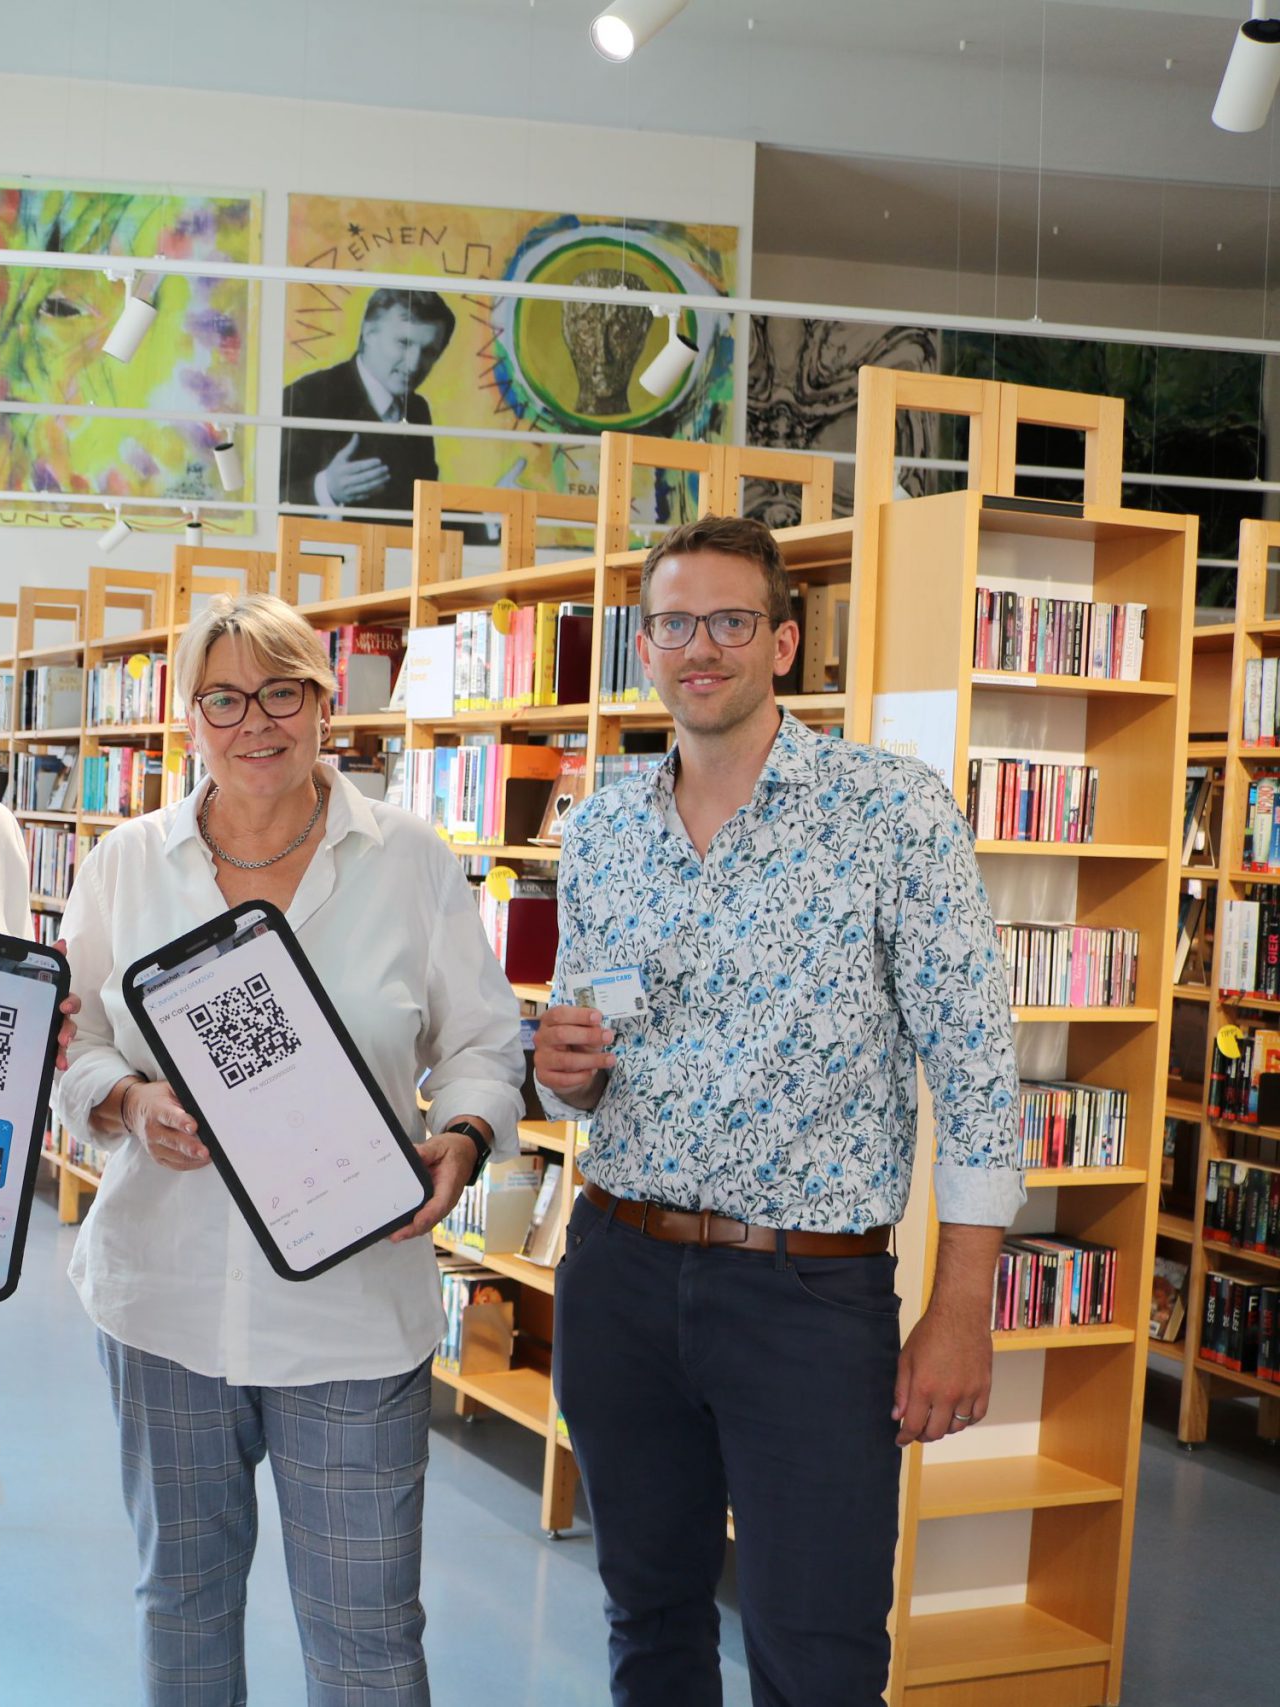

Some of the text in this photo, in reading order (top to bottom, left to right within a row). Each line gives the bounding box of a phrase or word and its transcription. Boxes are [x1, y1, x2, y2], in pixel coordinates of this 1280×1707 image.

[880, 738, 918, 755] Krimis
[1267, 934, 1279, 965] GIER
[146, 970, 182, 994] Schwechat
[158, 1003, 191, 1025] SW Card
[1207, 1296, 1216, 1324] SEVEN
[1232, 1307, 1241, 1332] FIFTY
